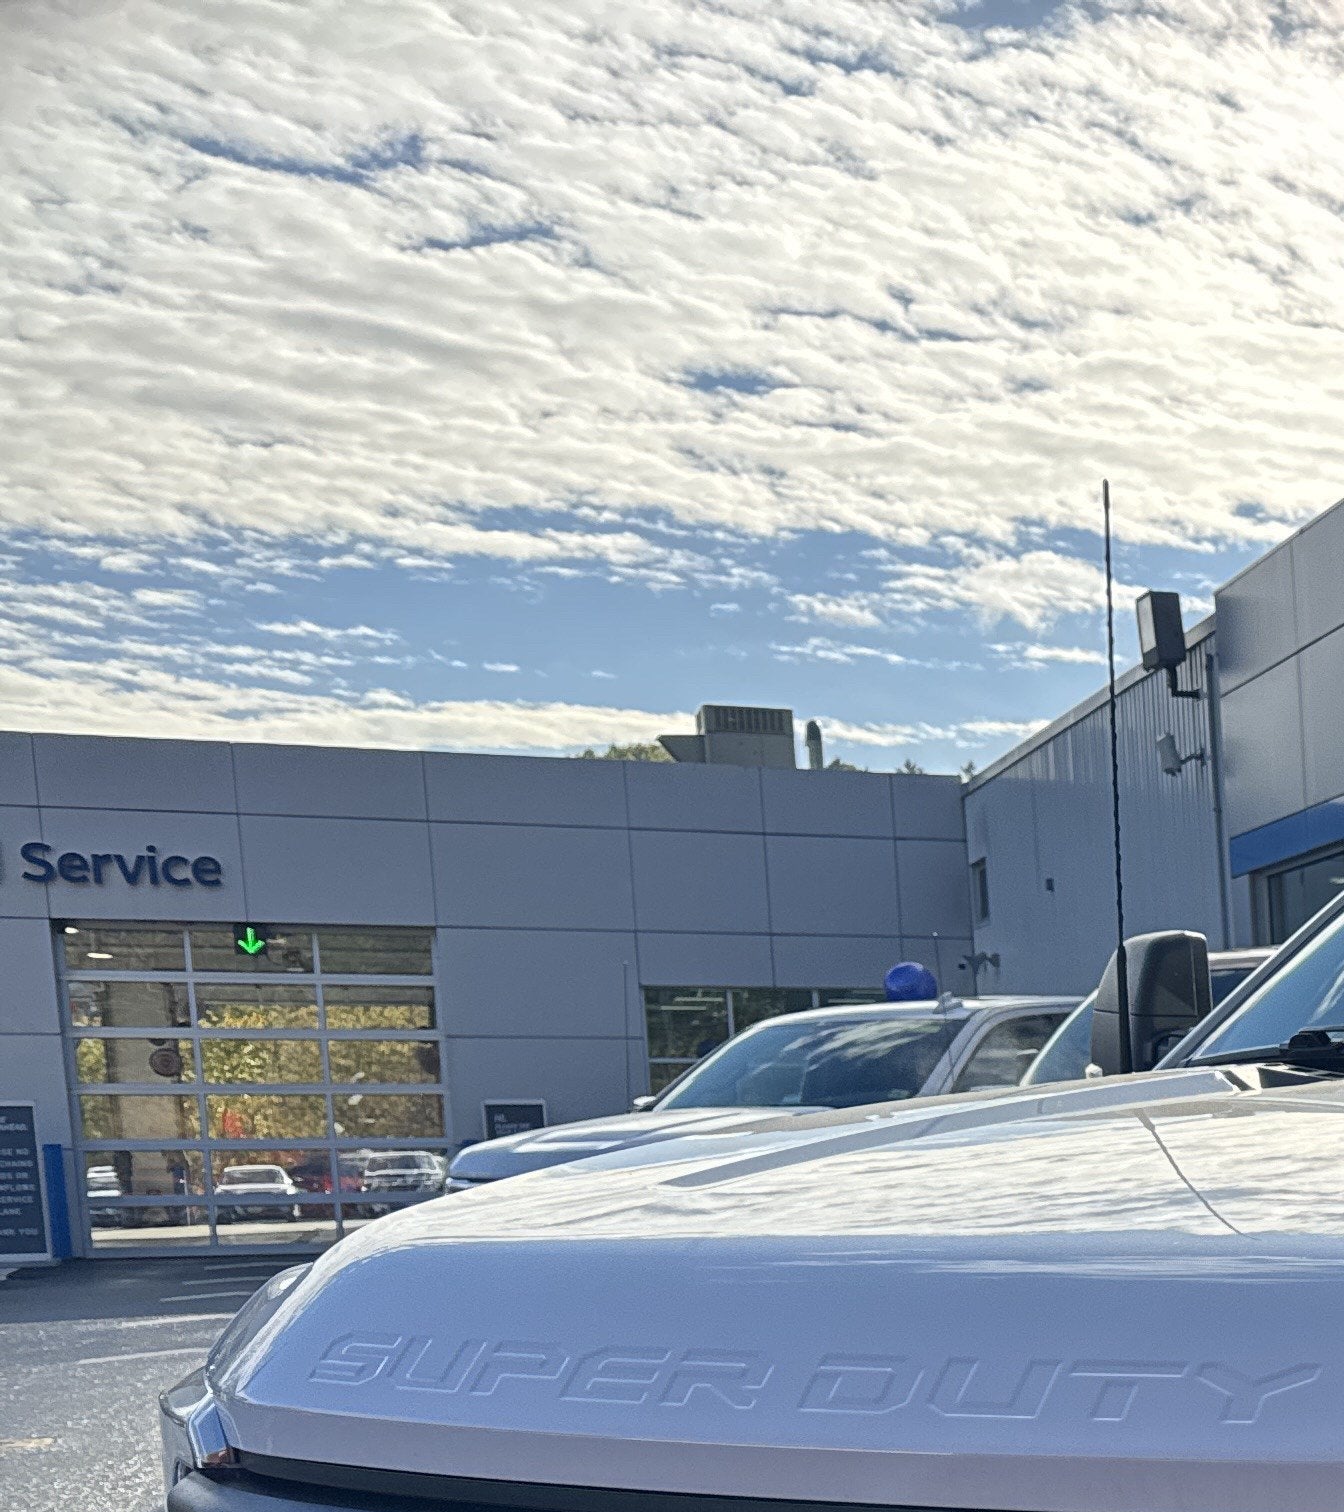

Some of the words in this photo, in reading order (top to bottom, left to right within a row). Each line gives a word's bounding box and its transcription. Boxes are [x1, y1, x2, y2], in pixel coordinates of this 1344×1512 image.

[20, 842, 223, 886] Service
[308, 1331, 775, 1409] SUPER
[798, 1353, 1322, 1425] DUTY
